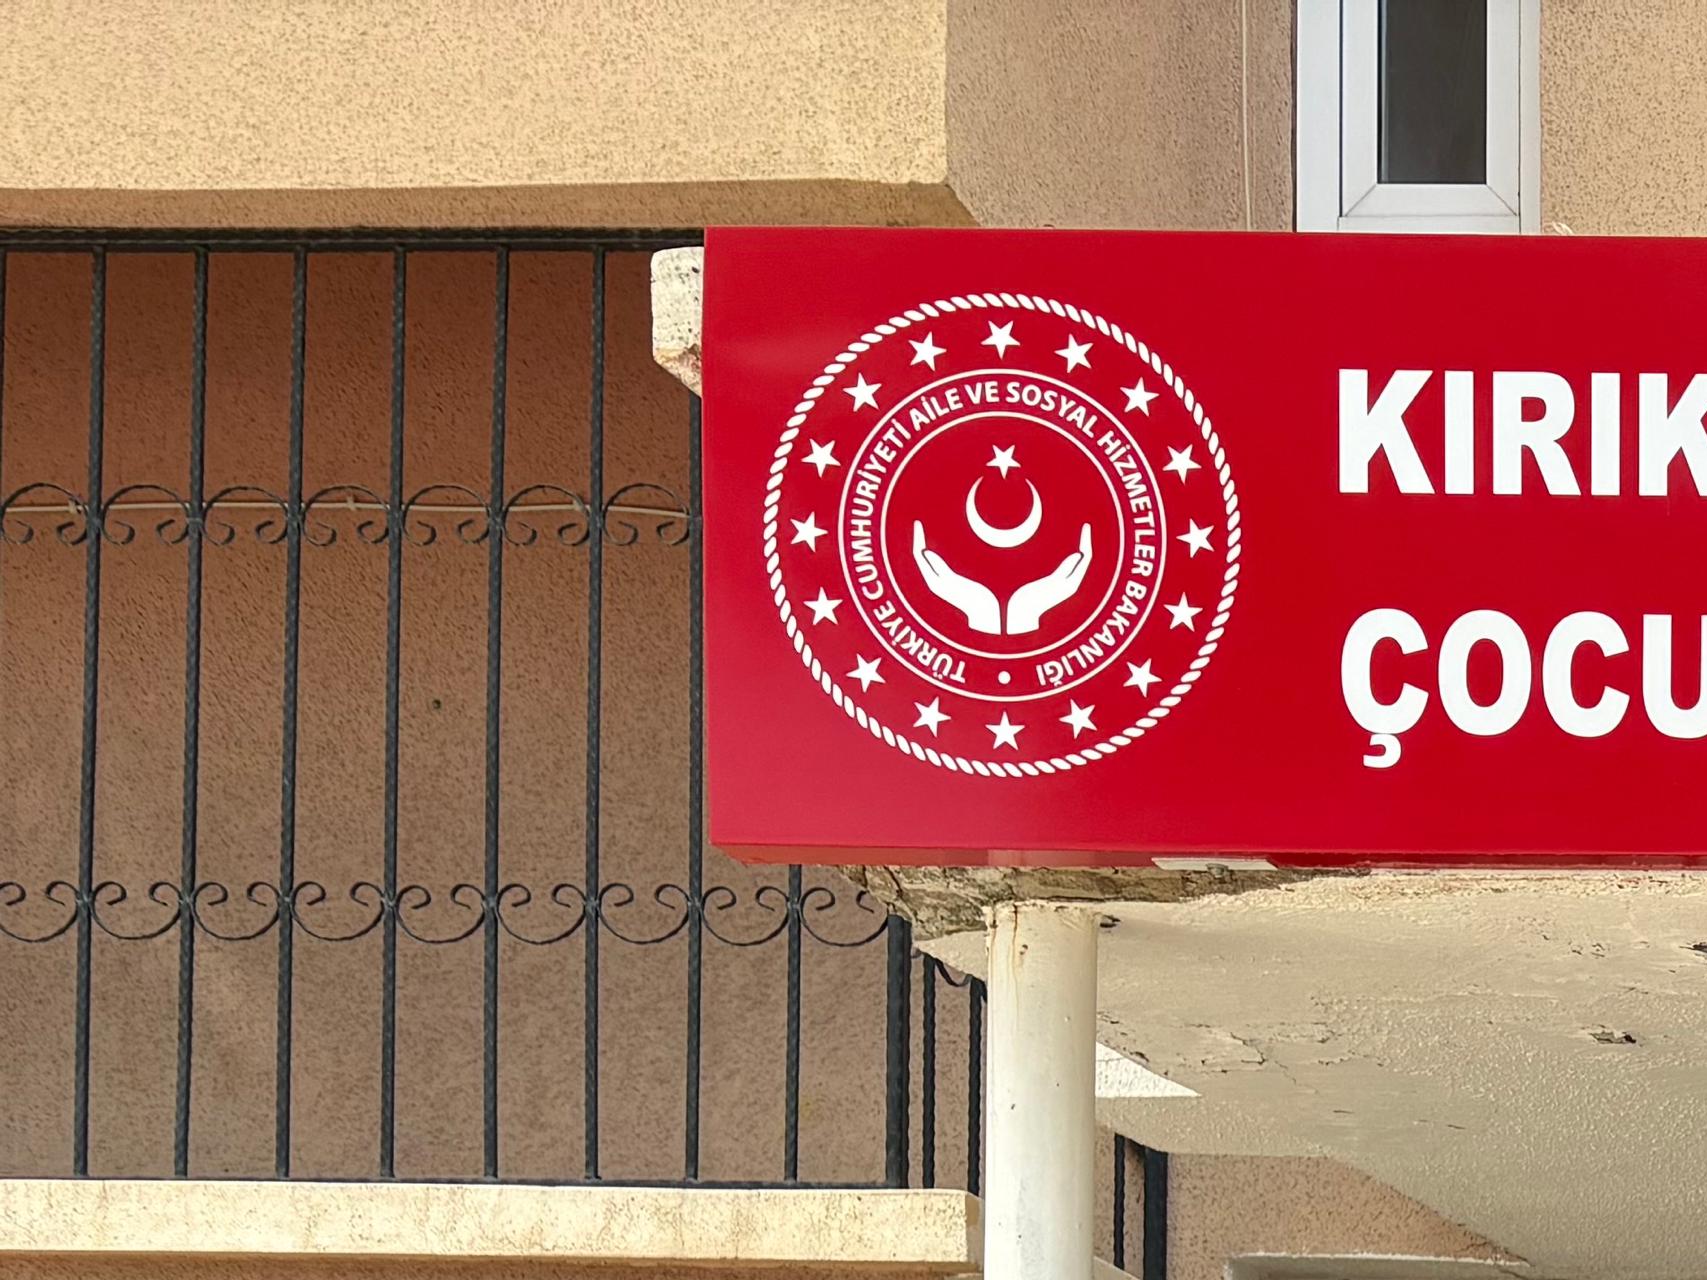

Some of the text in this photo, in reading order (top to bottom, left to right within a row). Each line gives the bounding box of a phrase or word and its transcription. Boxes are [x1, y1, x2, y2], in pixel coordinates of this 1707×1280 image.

[850, 381, 1156, 687] TÜRKİYE CUMHURİYETİ AİLE VE SOSYAL HİZMETLER BAKANLIĞI
